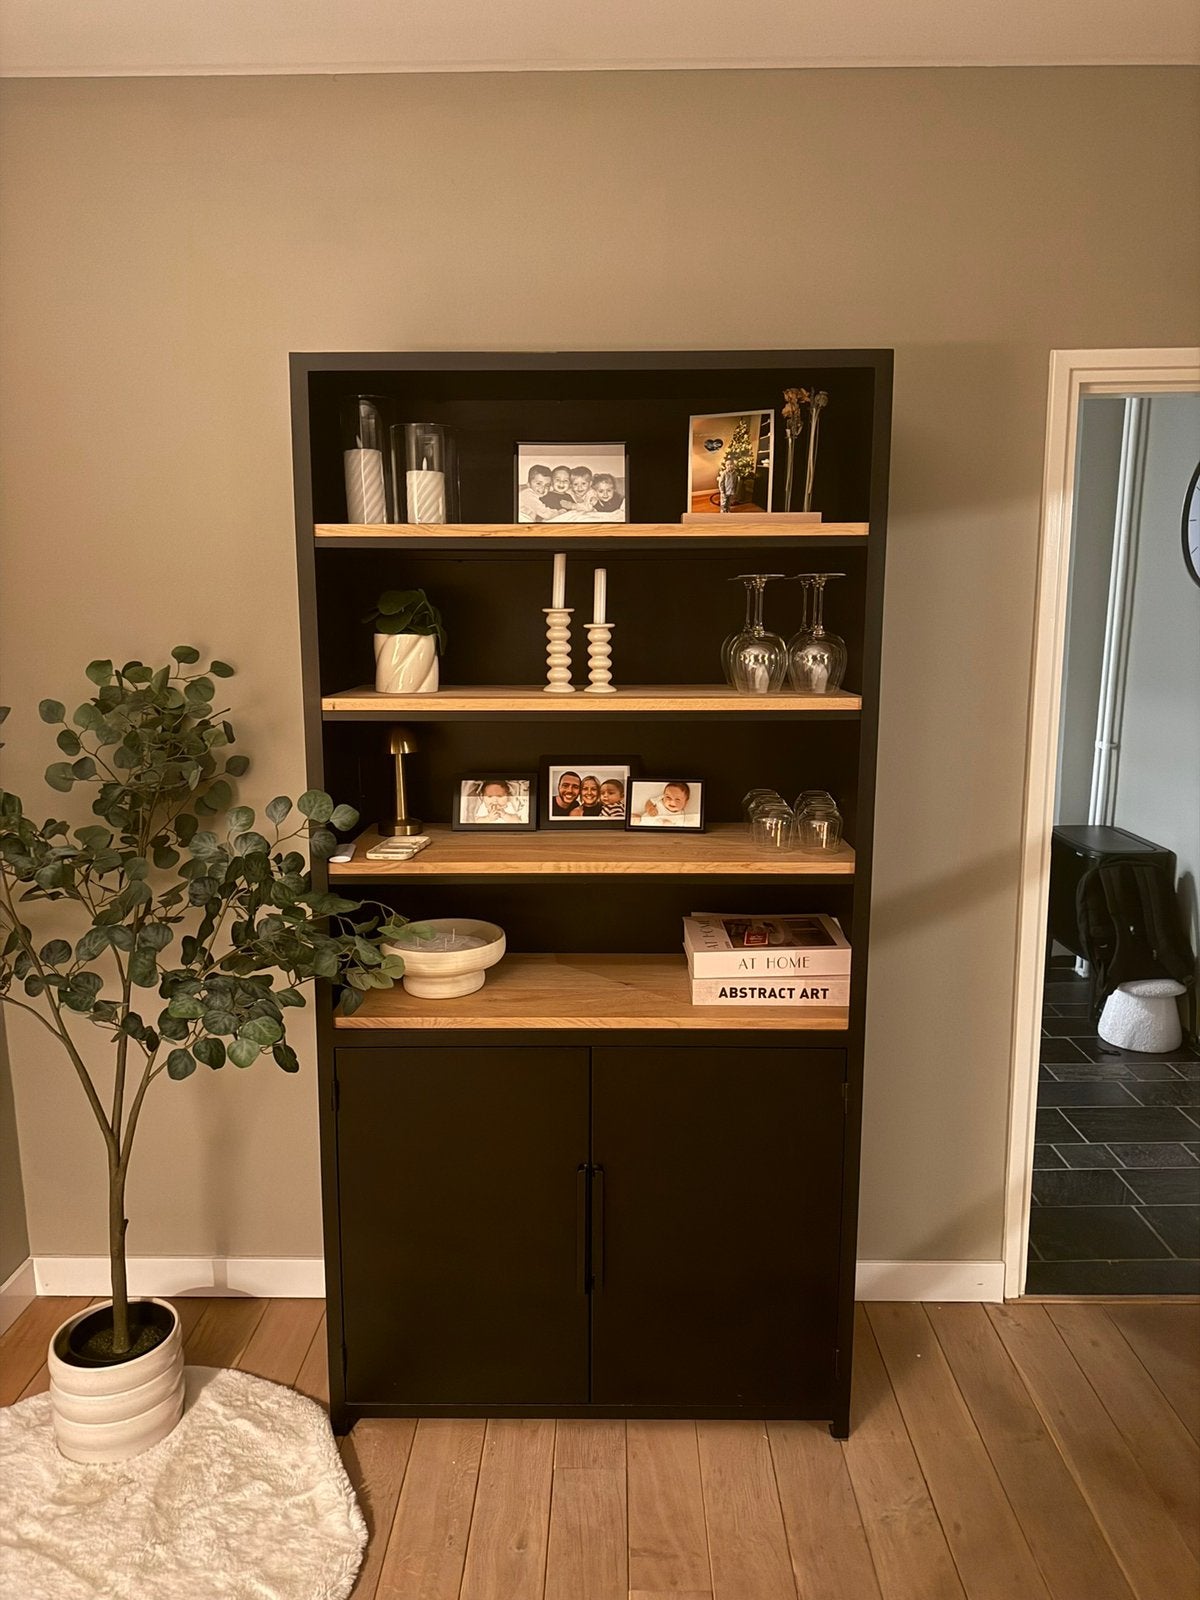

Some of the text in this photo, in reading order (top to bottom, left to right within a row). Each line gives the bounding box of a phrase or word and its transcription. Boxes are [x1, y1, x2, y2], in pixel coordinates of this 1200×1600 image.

[738, 956, 810, 970] AT HOME
[718, 987, 830, 999] ABSTRACT ART
